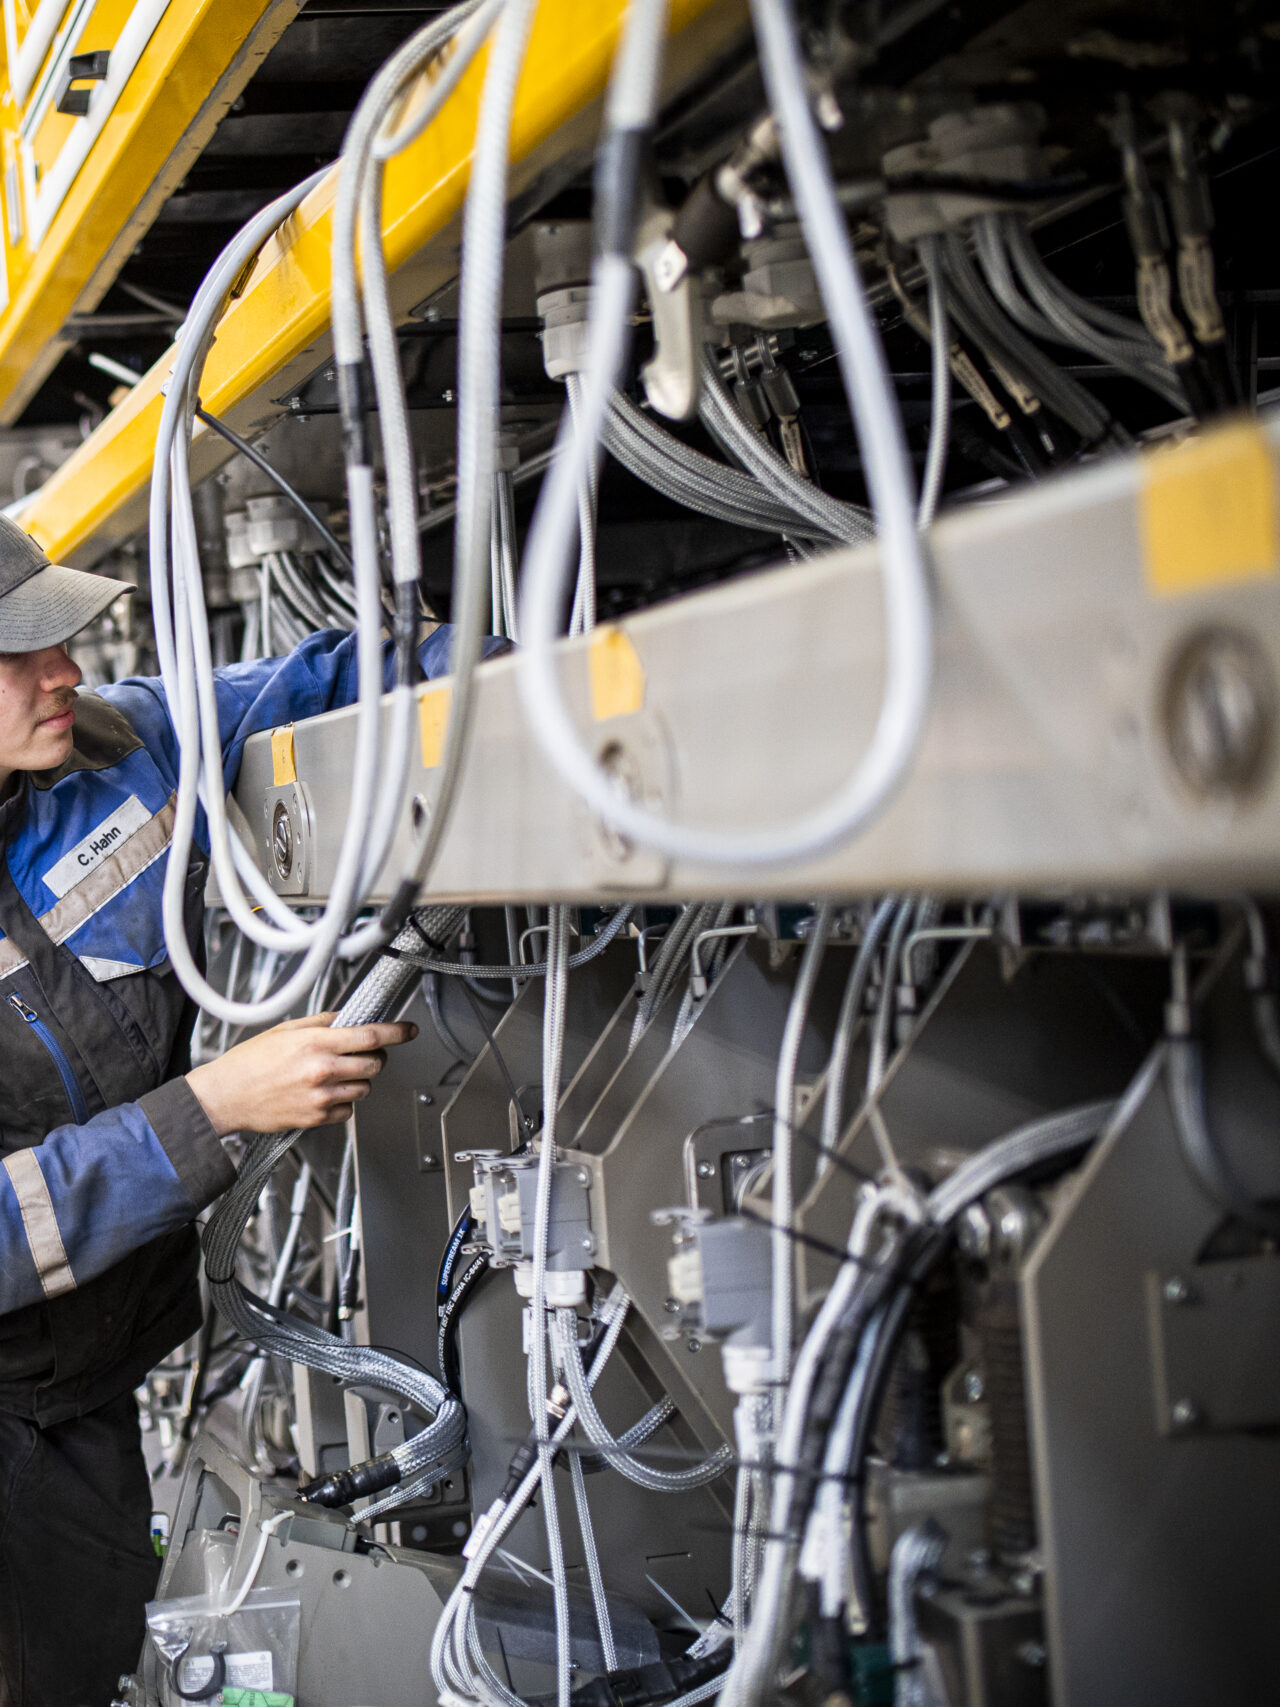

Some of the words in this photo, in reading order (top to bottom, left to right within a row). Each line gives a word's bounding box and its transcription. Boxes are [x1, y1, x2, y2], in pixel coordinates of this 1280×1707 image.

[77, 853, 94, 866] C.
[89, 826, 122, 856] Hahn
[441, 1238, 461, 1286] SUPERSTREAM
[451, 1281, 466, 1302] MSHA
